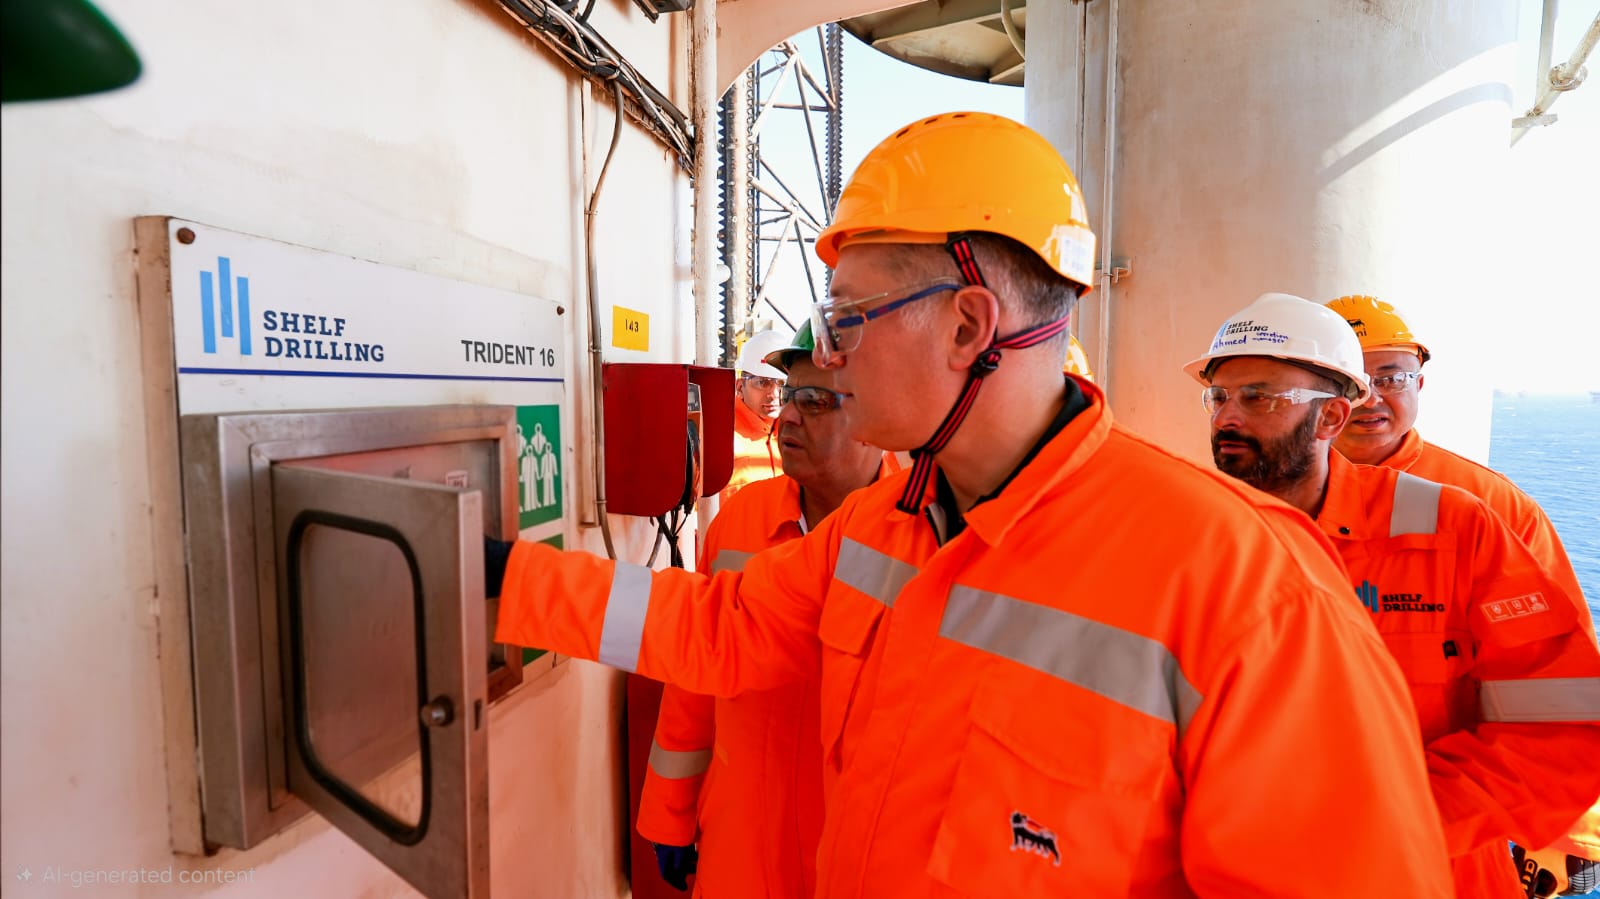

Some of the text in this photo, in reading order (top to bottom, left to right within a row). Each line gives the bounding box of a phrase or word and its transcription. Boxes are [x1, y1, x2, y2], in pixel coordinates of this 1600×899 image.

[263, 310, 346, 336] SHELF
[624, 318, 639, 333] 143
[1227, 320, 1254, 329] SHELF
[1226, 325, 1268, 335] DRILLING
[264, 336, 384, 362] DRILLING
[461, 339, 555, 367] TRIDENT 16
[1382, 594, 1422, 602] SHELF
[1384, 603, 1445, 612] DRILLING
